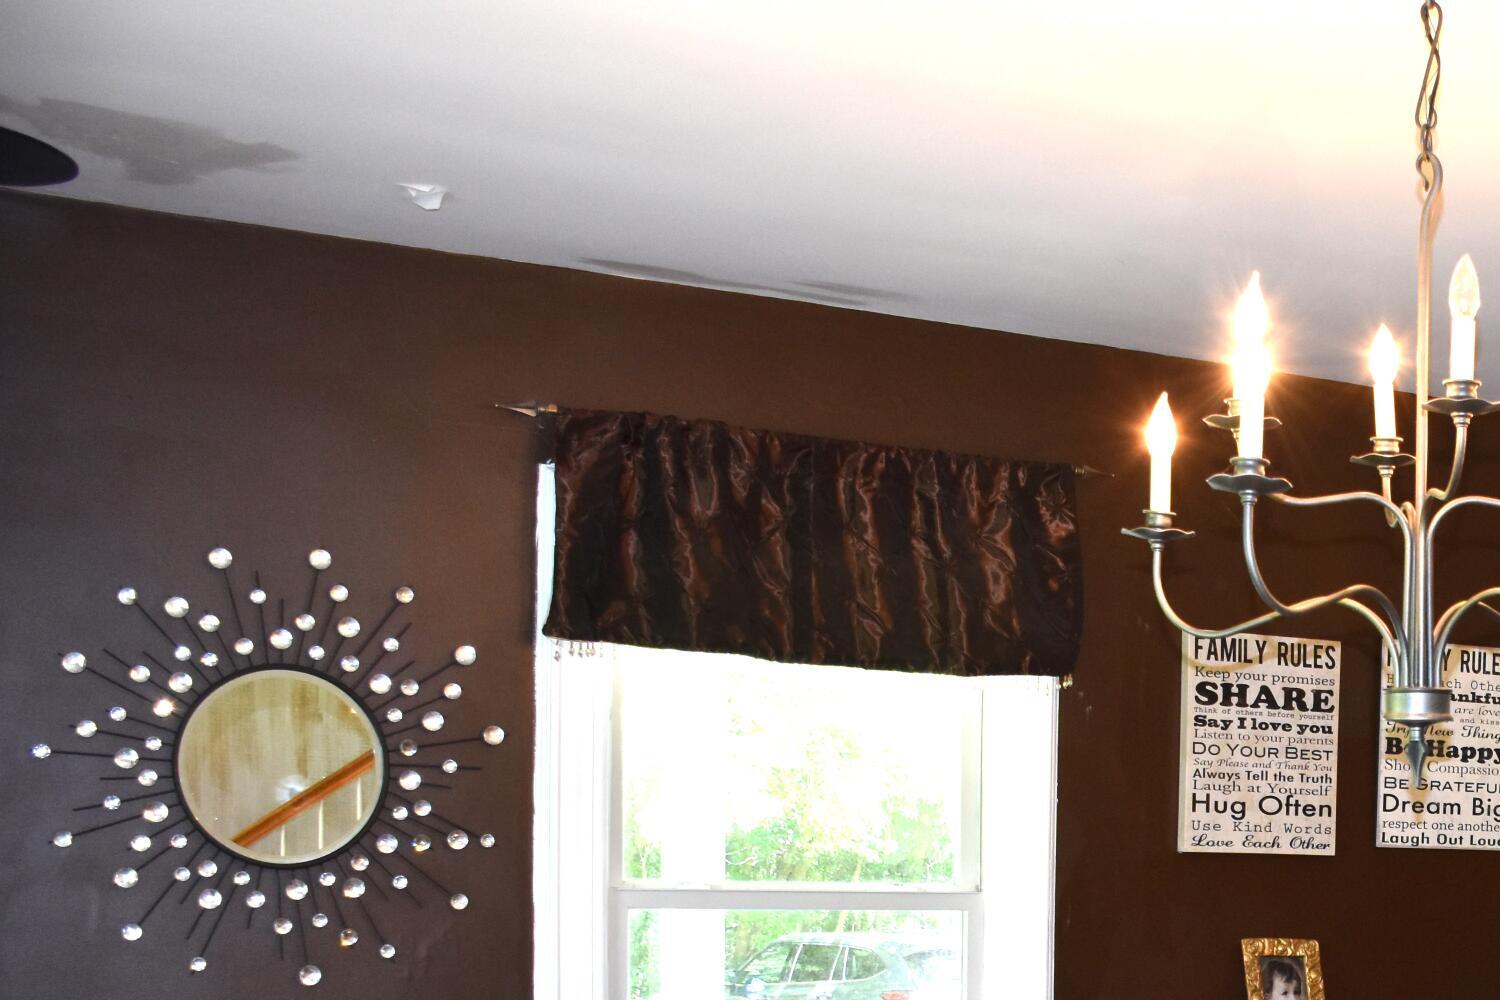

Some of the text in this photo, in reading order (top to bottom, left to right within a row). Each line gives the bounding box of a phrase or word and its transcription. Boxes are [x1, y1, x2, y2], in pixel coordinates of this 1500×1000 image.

[1195, 637, 1336, 670] FAMILY RULES
[1195, 666, 1335, 686] Keep your promises
[1195, 681, 1335, 713] SHARE
[1194, 706, 1217, 714] Think
[1194, 715, 1333, 735] Say I love you
[1194, 729, 1334, 747] Listen to your parents
[1227, 744, 1279, 759] YOUR
[1286, 747, 1333, 761] BEST
[1193, 758, 1213, 767] Say
[1216, 759, 1248, 767] Please
[1252, 760, 1273, 769] and
[1275, 761, 1310, 771] Thank
[1385, 759, 1410, 771] Sho
[1193, 768, 1332, 784] Always Tell the Truth
[1384, 777, 1408, 789] BE
[1193, 780, 1331, 796] Laugh at Yourself
[1192, 793, 1331, 820] Hug Often
[1382, 794, 1460, 815] Dream
[1192, 820, 1331, 835] Use Kind Words
[1382, 820, 1428, 832] respect
[1431, 822, 1454, 830] one
[1191, 834, 1330, 849] Love Each Other
[1382, 832, 1429, 846] Laugh
[1437, 834, 1463, 845] Out
